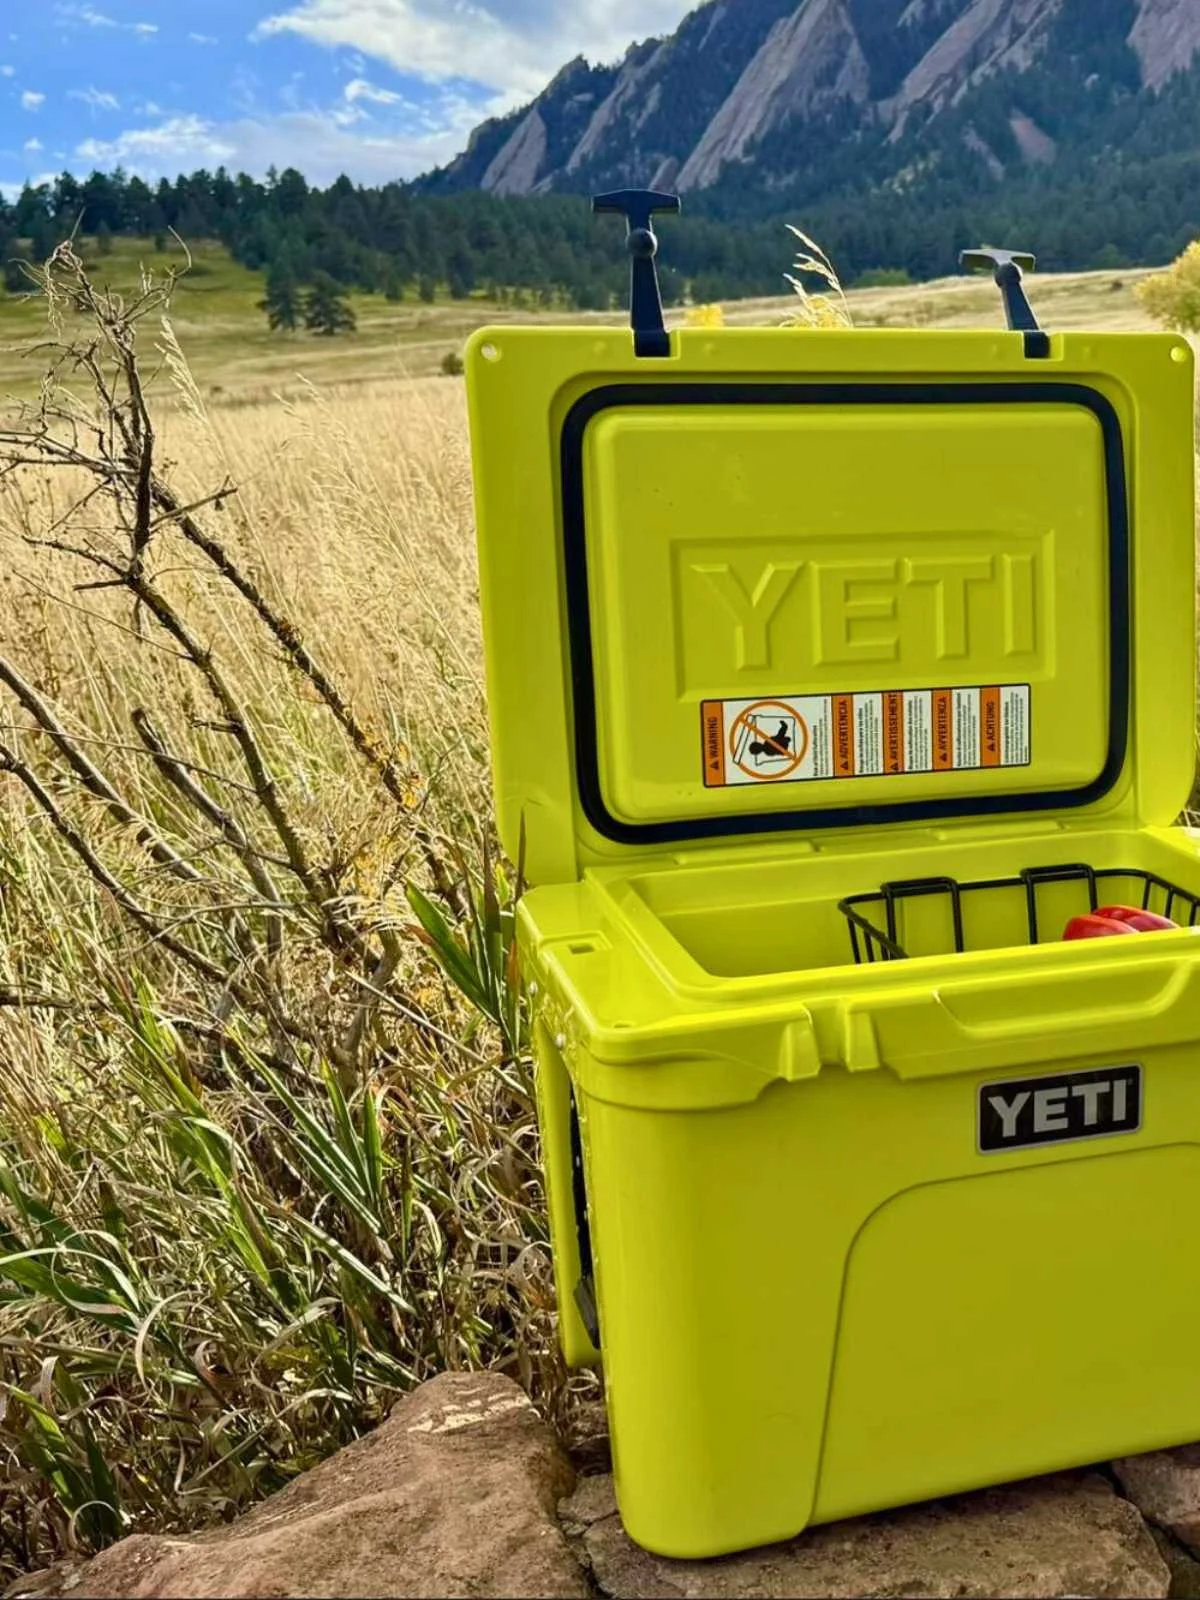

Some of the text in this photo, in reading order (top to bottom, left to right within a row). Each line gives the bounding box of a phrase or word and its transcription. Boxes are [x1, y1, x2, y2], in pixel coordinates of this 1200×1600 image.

[689, 553, 1036, 670] YETI
[708, 717, 719, 758] WARNING
[839, 700, 849, 760] ADVERTENCIA
[887, 694, 899, 761] AVERTISSEMENT
[937, 696, 948, 750] AVVERTENZA
[986, 701, 996, 742] ACHTUNG
[988, 1079, 1127, 1138] YETI
